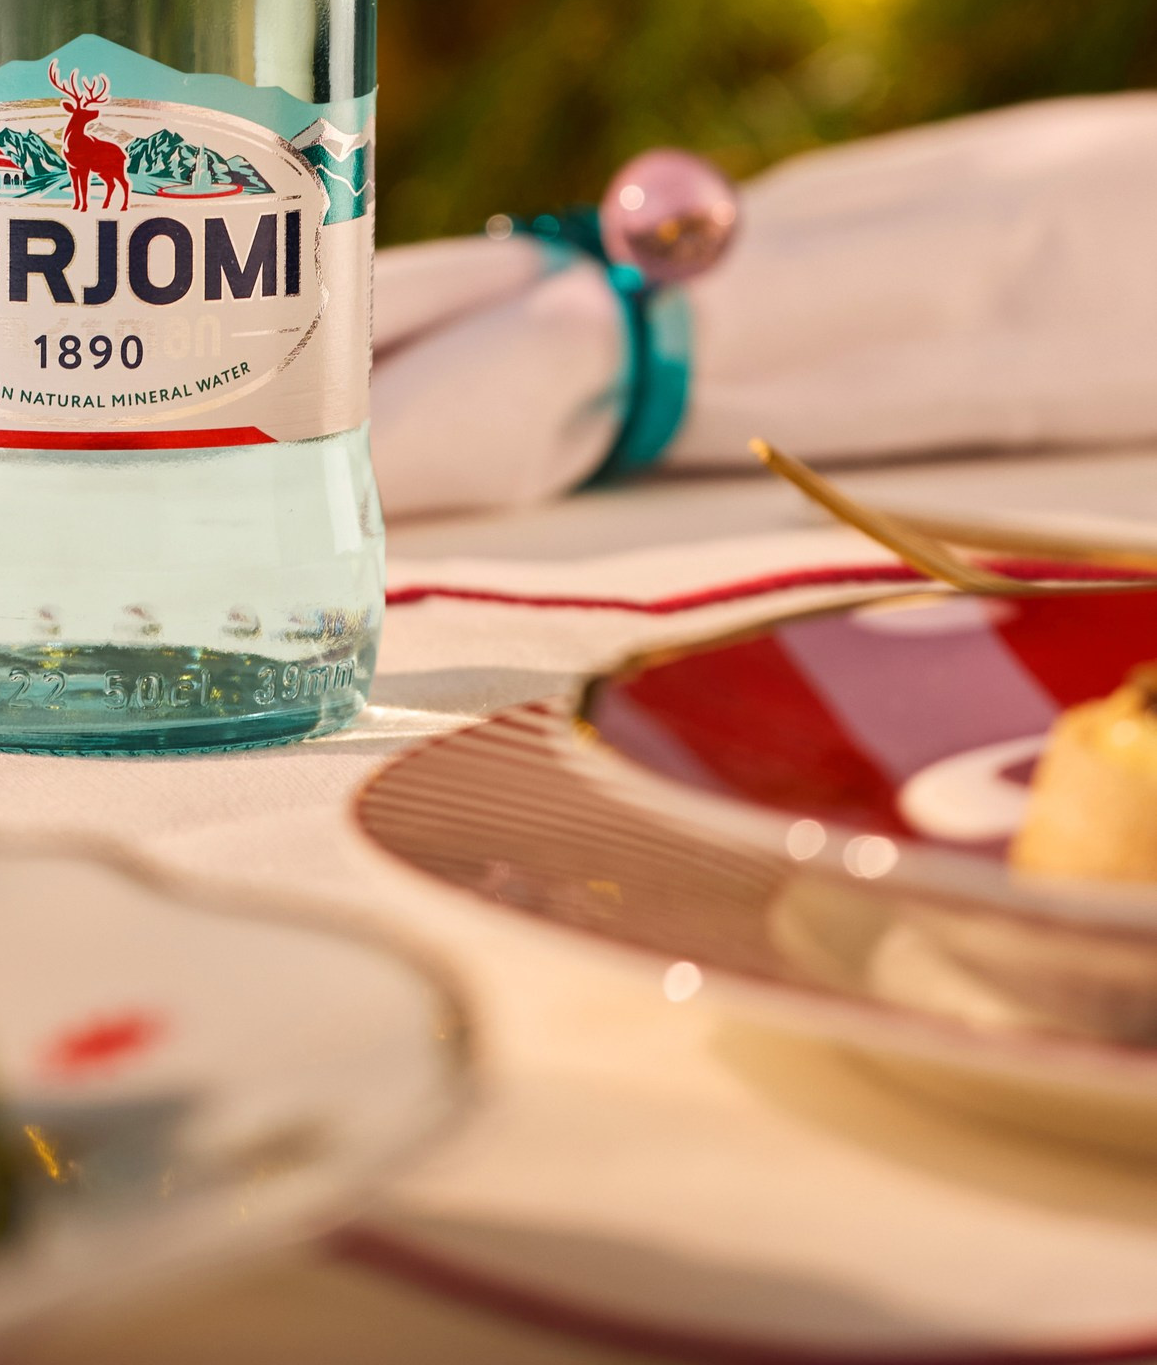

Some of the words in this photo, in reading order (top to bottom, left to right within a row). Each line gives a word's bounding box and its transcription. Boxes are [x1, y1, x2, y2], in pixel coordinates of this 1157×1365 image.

[34, 334, 144, 370] 1890
[19, 389, 106, 409] NATURAL
[111, 384, 193, 408] MINERAL
[196, 361, 252, 393] WATER
